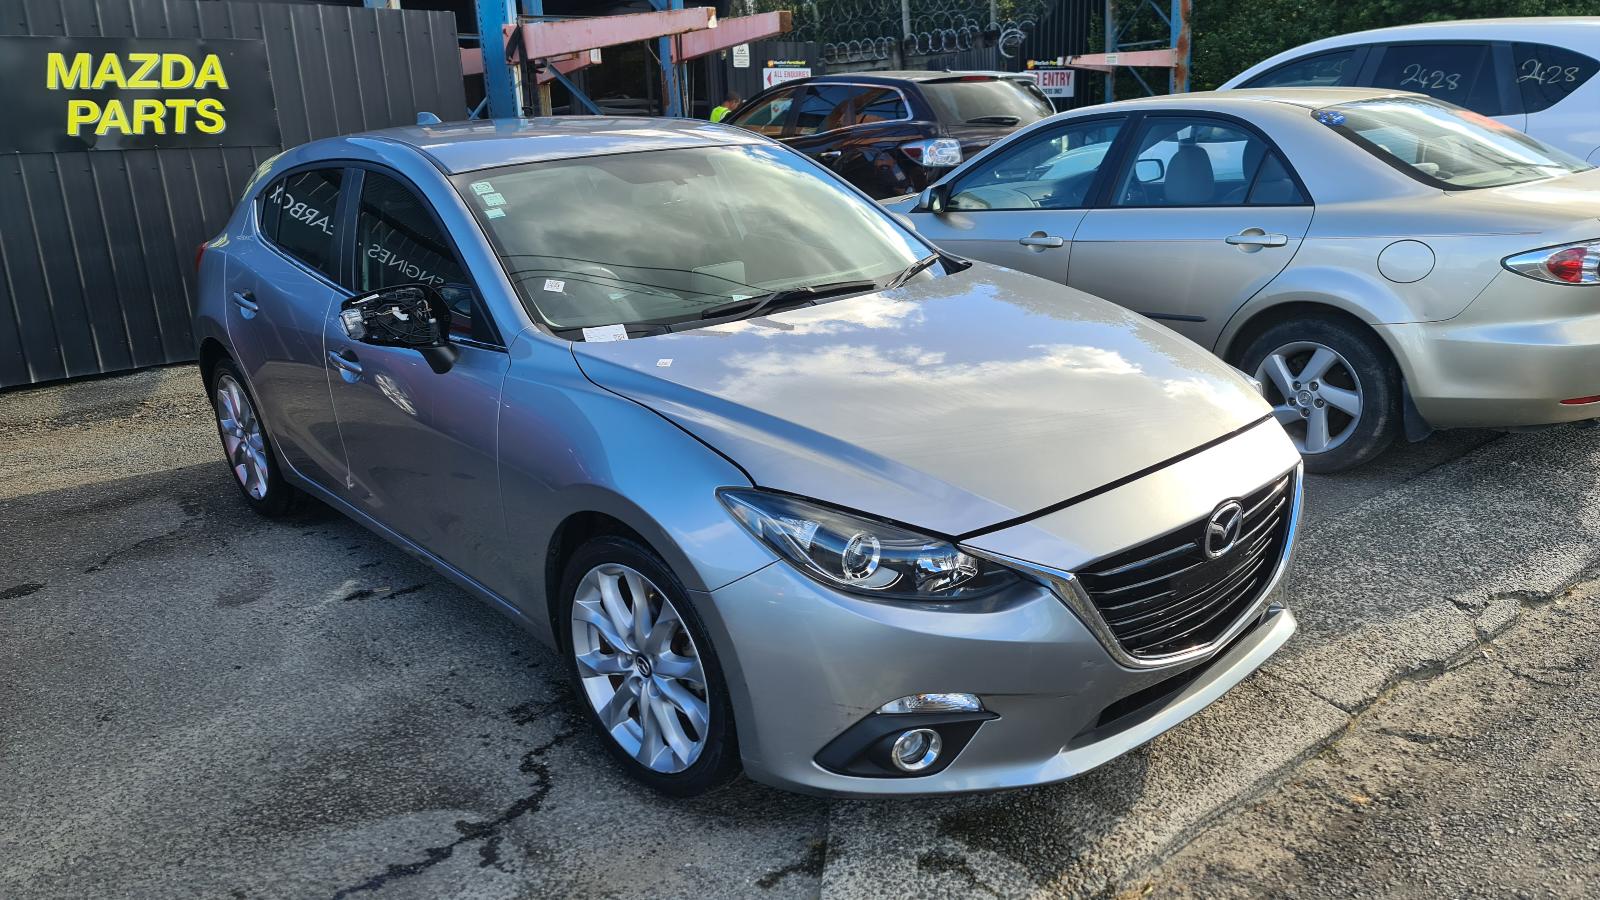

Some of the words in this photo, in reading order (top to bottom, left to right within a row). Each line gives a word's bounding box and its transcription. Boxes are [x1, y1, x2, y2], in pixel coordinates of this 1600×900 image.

[47, 52, 229, 89] MAZDA
[774, 70, 782, 78] ALL
[1042, 71, 1071, 87] ENTRY
[1400, 63, 1462, 90] 2428
[1516, 58, 1579, 85] 2428
[67, 98, 226, 136] PARTS
